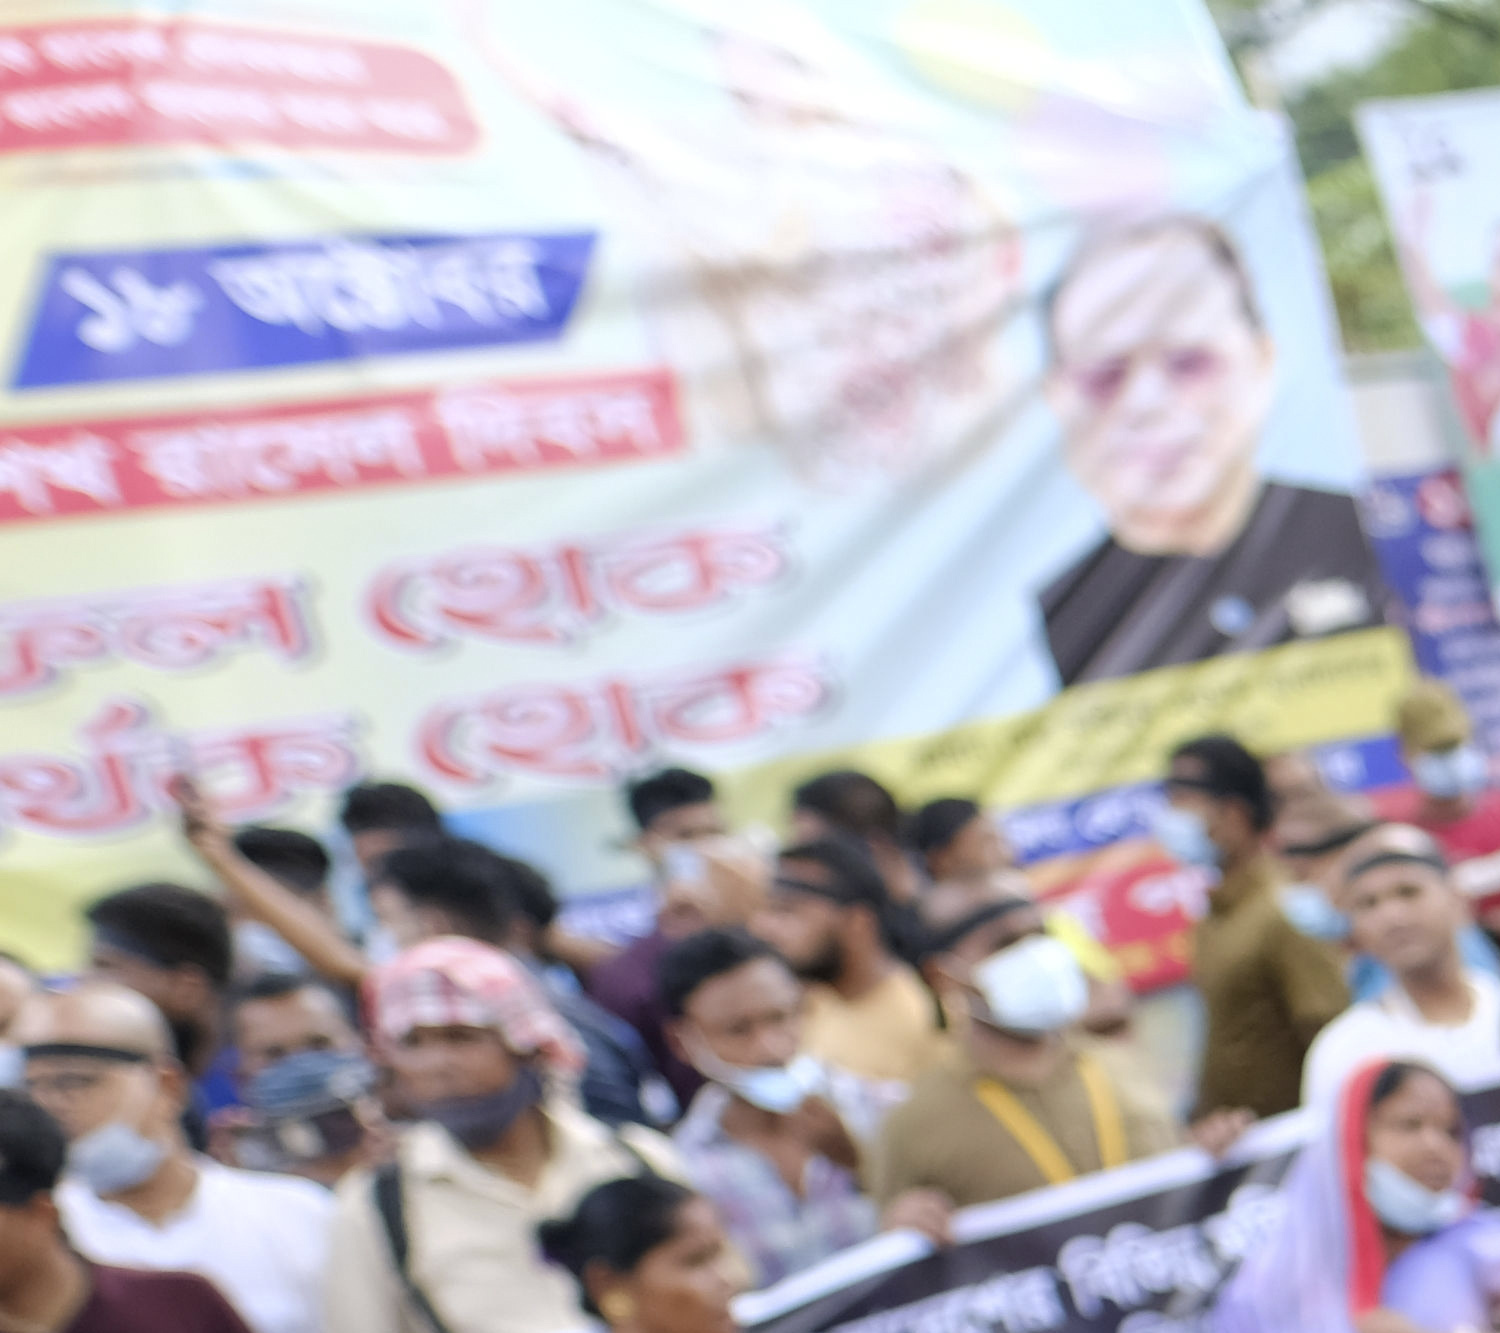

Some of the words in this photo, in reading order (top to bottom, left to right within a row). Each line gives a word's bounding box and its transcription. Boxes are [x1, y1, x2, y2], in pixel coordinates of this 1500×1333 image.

[0, 572, 318, 698] ফল
[362, 520, 800, 650] হোক
[414, 650, 842, 786] হোক
